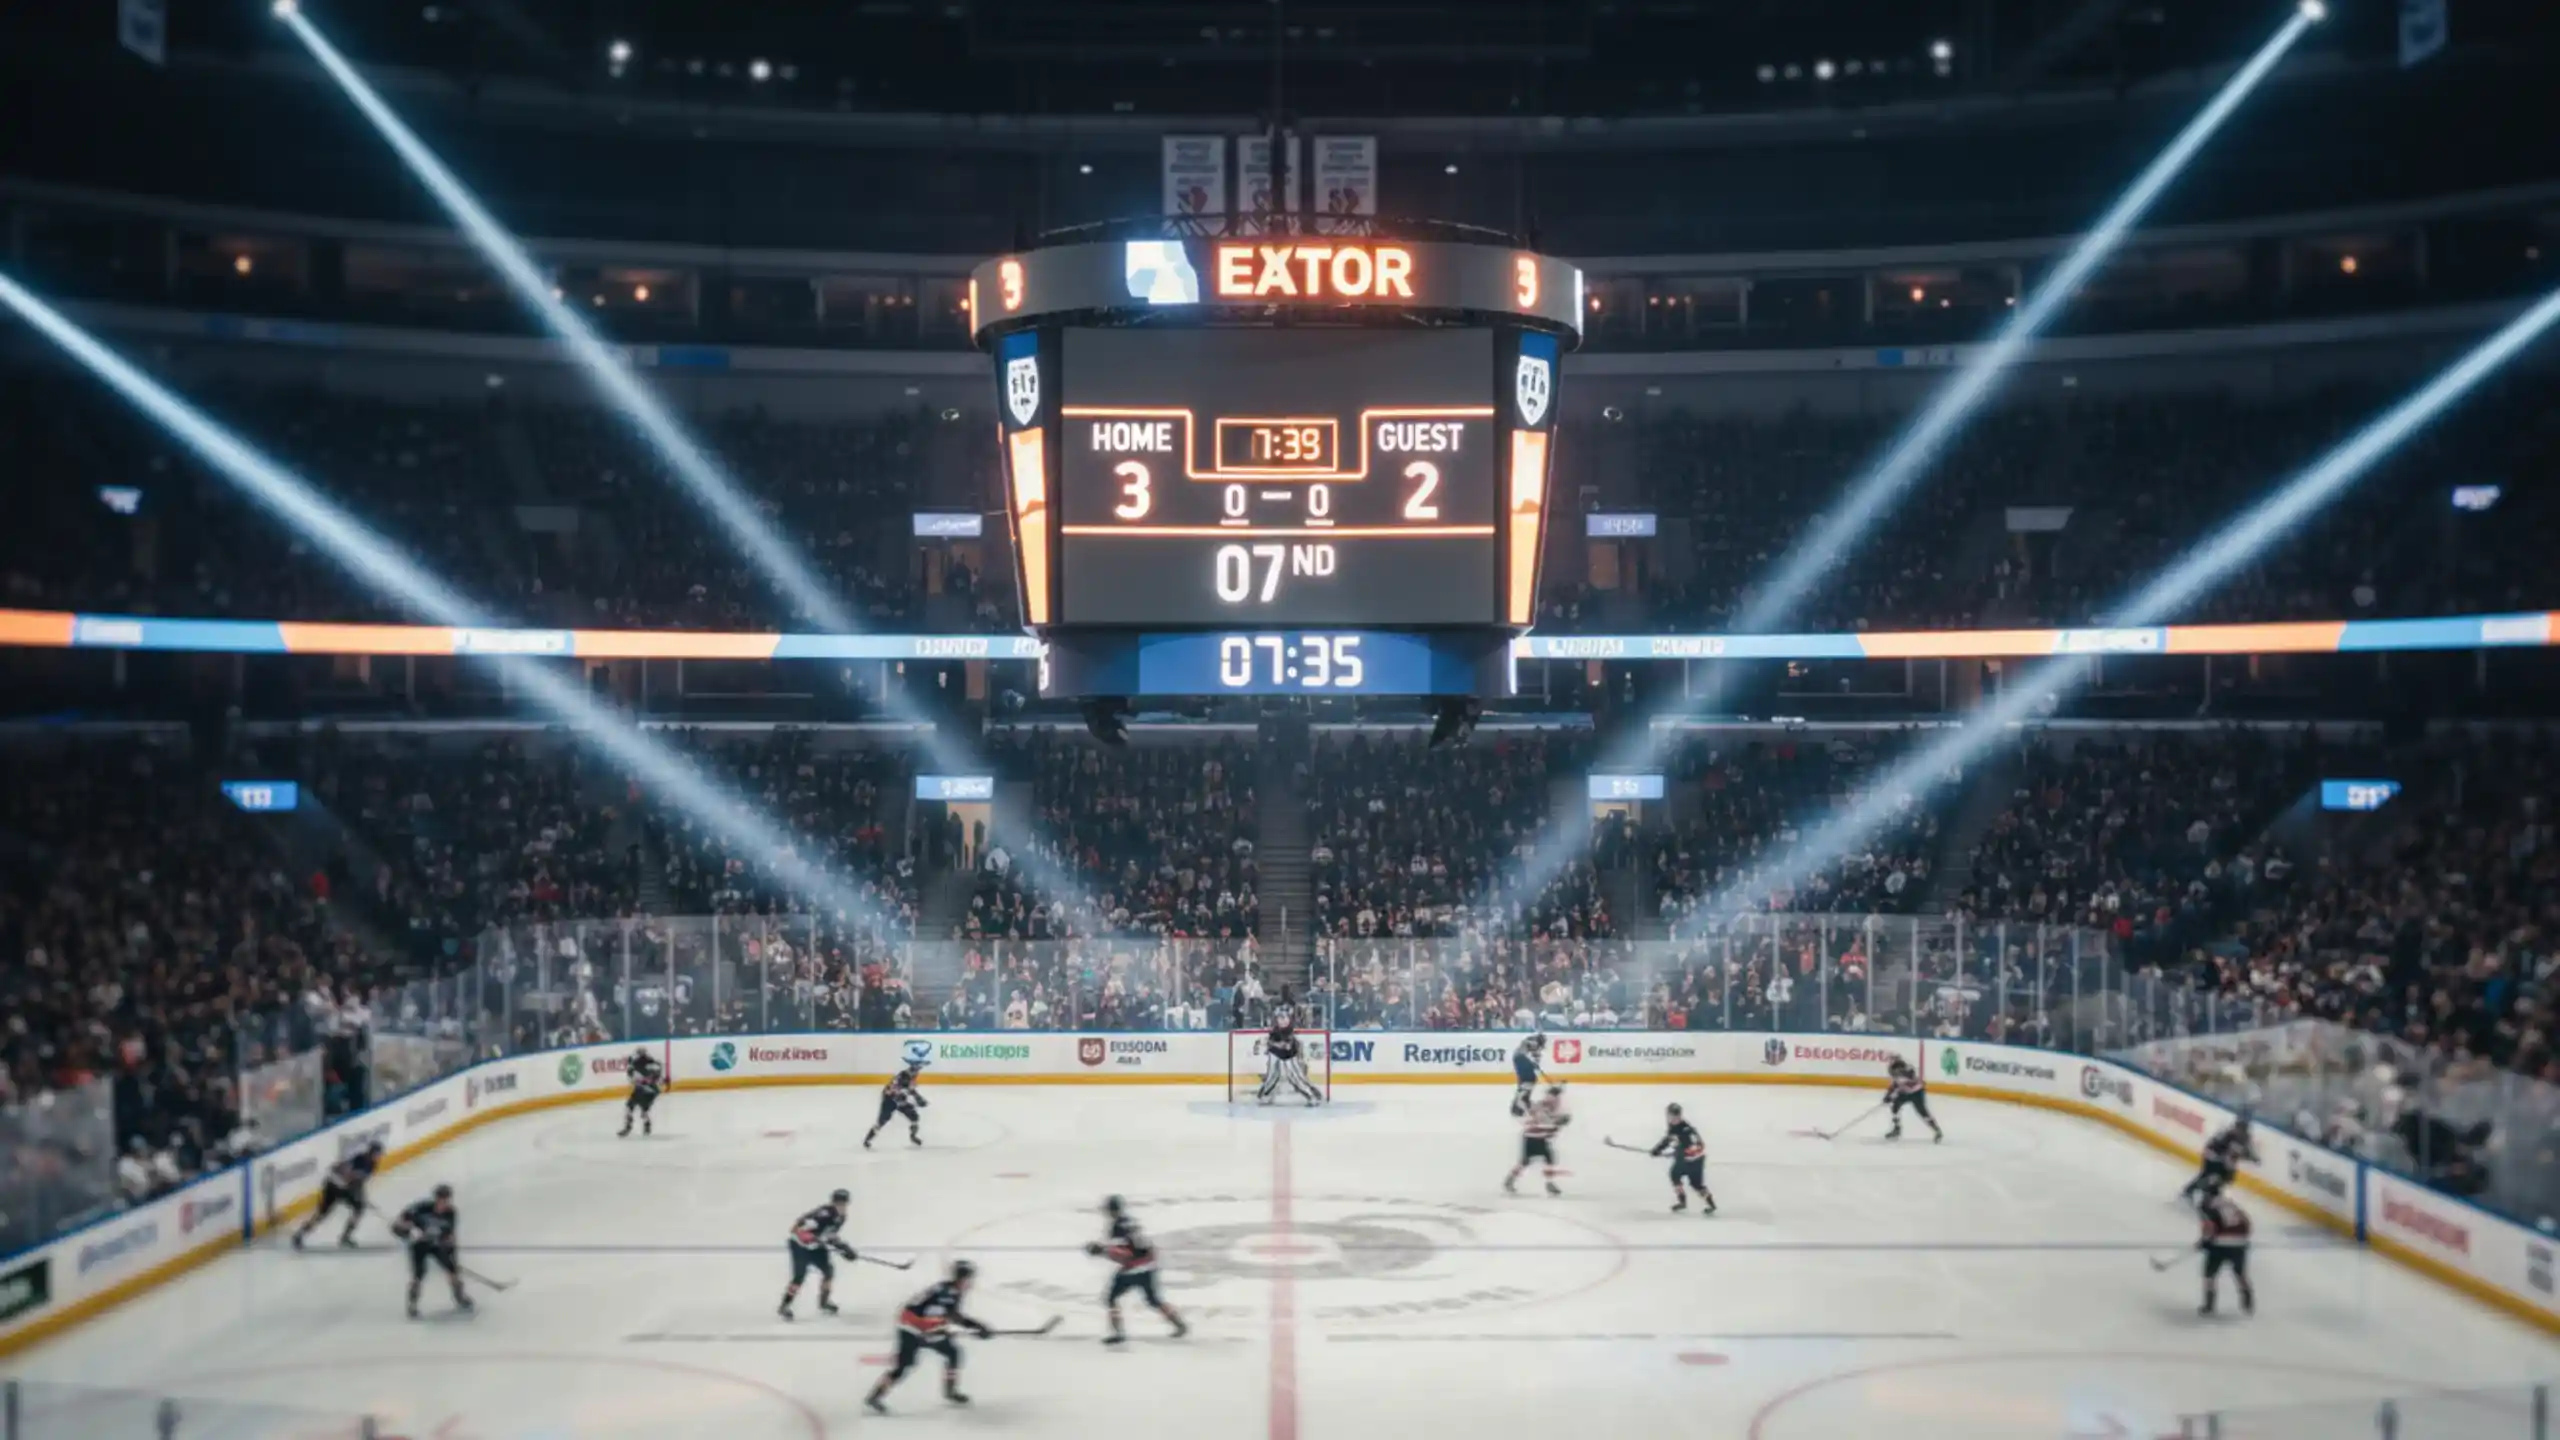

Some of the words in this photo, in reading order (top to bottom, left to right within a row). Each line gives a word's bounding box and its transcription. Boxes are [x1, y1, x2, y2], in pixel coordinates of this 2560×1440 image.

[1000, 260, 1024, 310] 3
[1218, 246, 1414, 298] EXTOR
[1516, 258, 1539, 308] 3
[1093, 422, 1172, 452] HOME
[1377, 422, 1464, 452] GUEST
[1114, 461, 1151, 520] 3
[1403, 461, 1440, 520] 2
[1220, 635, 1364, 688] 07:35
